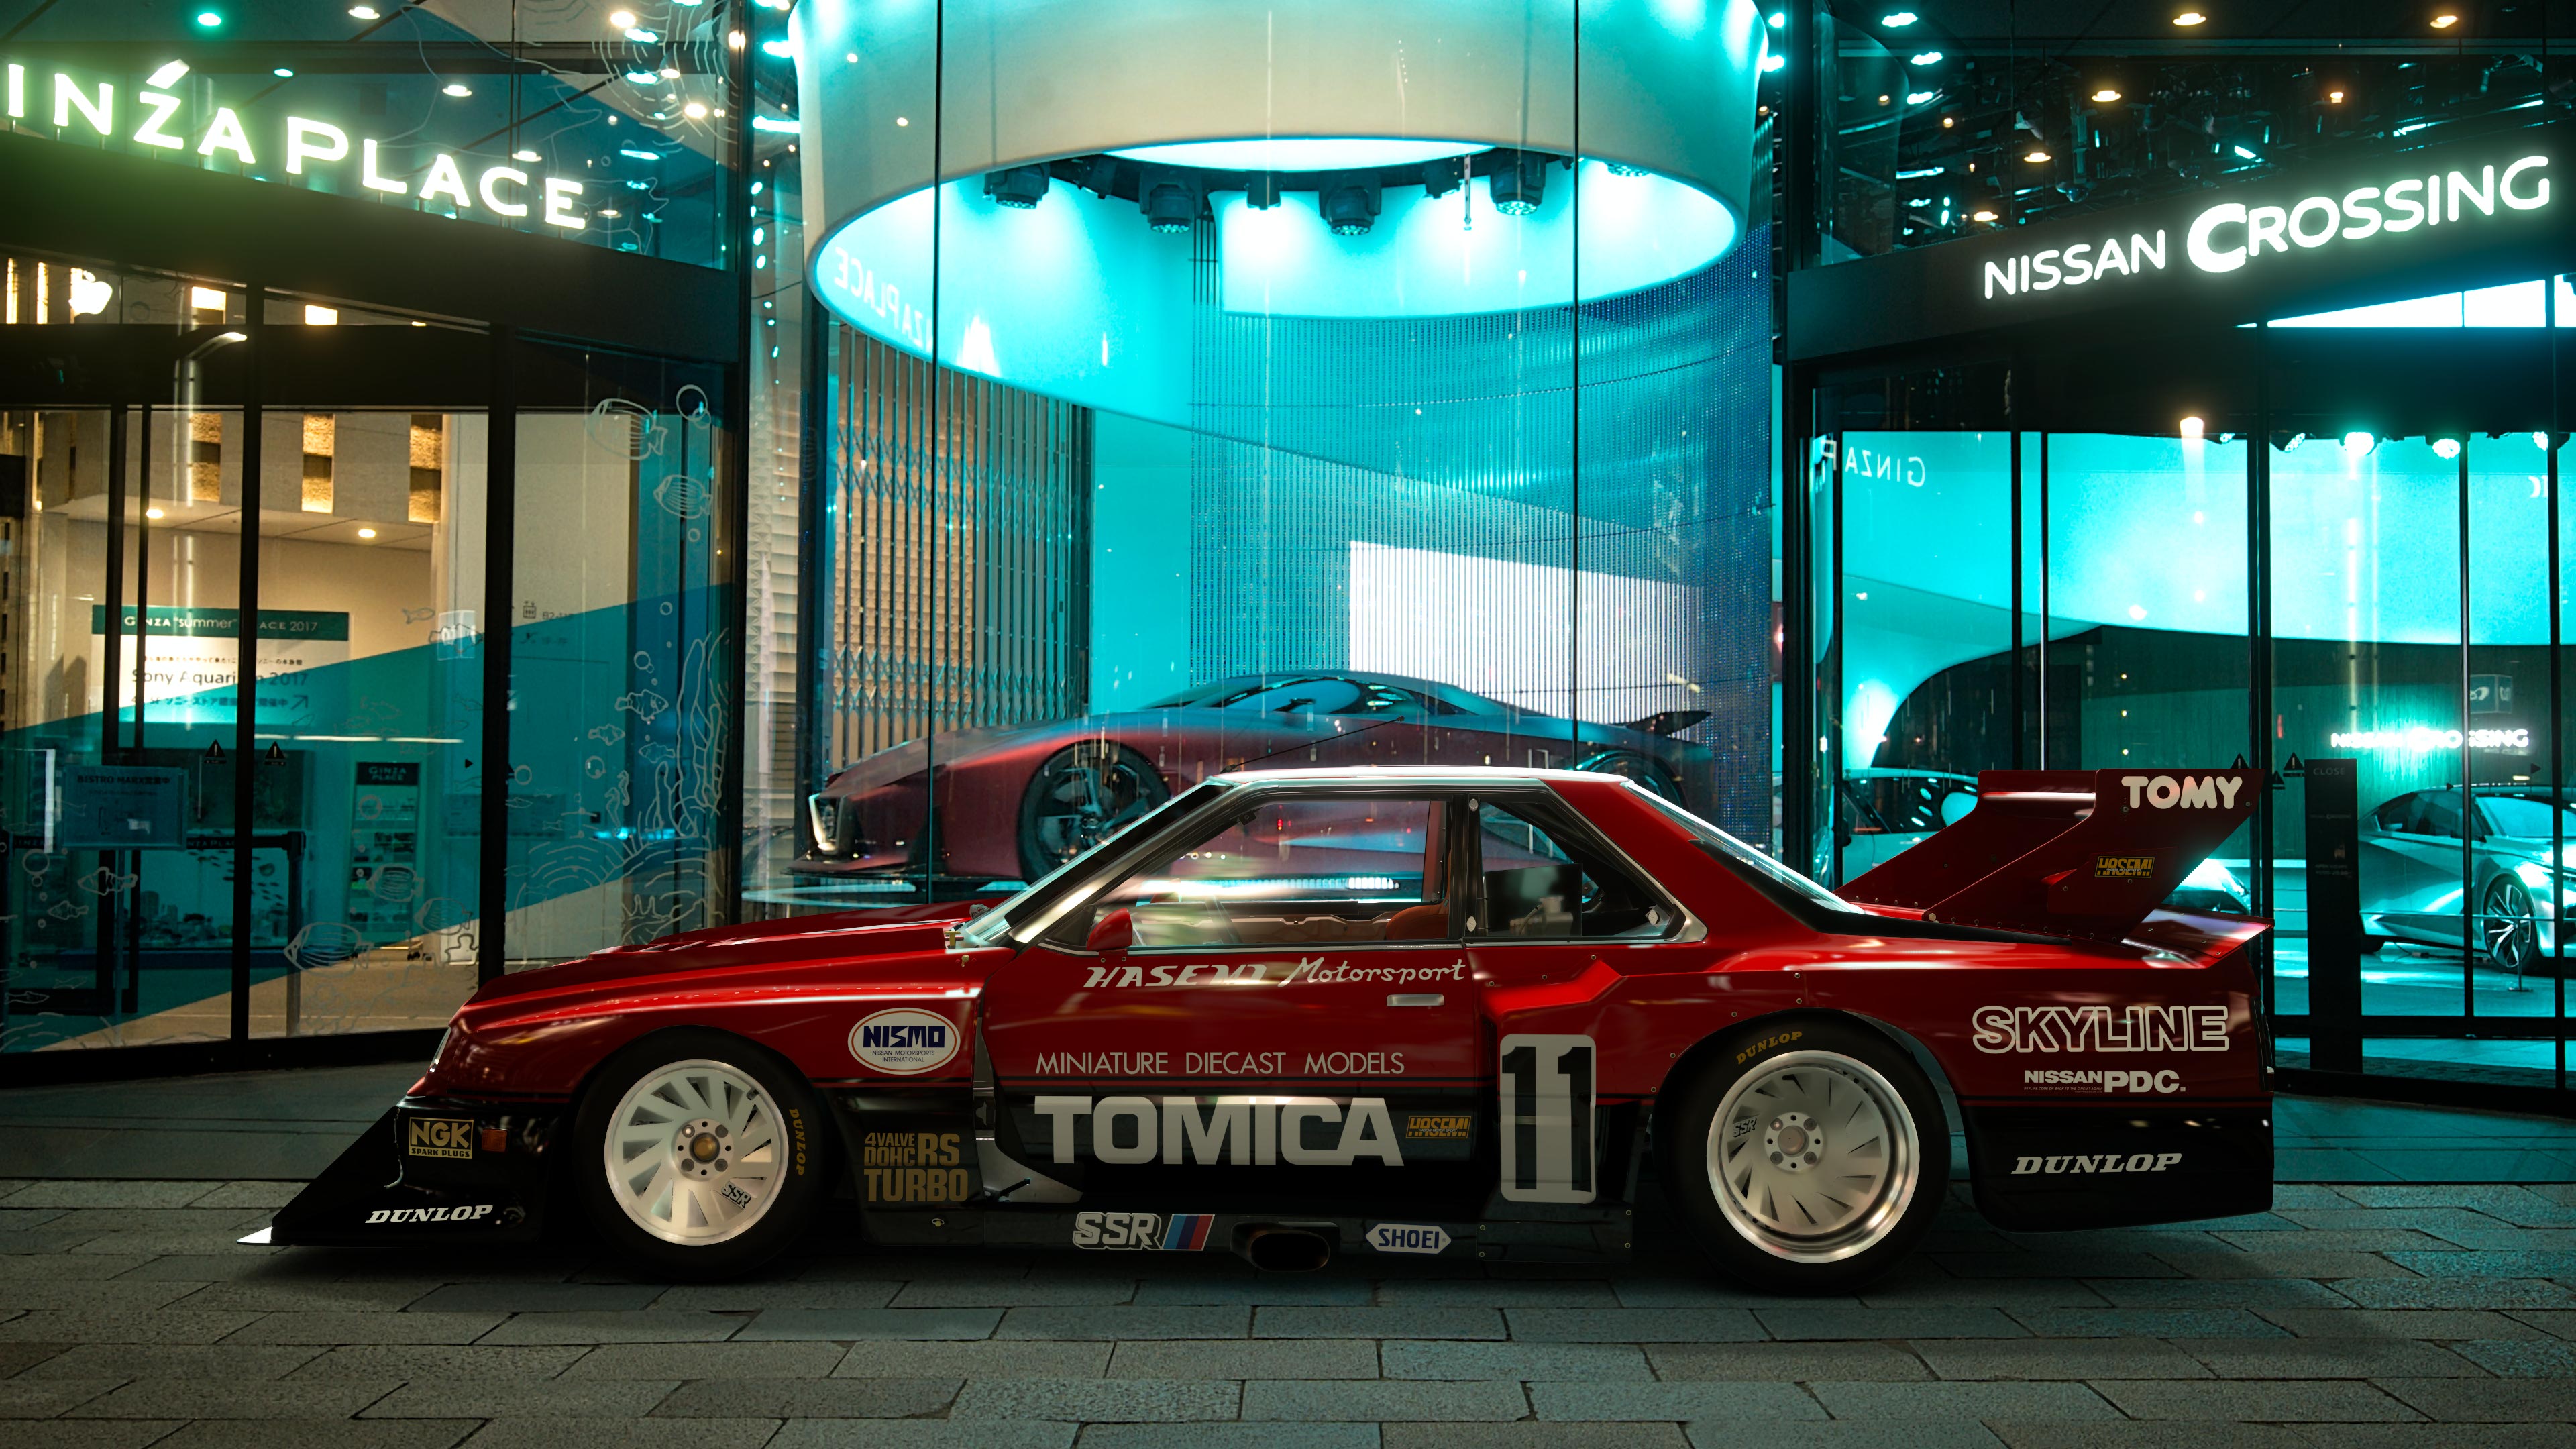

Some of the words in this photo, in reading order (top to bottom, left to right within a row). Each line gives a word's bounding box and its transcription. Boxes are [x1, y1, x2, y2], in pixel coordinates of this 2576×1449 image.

[286, 115, 586, 230] PLACE
[1984, 229, 2165, 299] NISSAN
[2186, 155, 2550, 274] CROSSING
[124, 616, 171, 627] GNZA
[290, 621, 318, 631] 2017
[268, 672, 309, 686] 2017
[2312, 767, 2346, 776] CLOSE
[2121, 775, 2243, 810] TOMY
[2096, 857, 2153, 877] HASEMI
[1082, 963, 1268, 988] HASEMI
[1277, 957, 1466, 987] Motorsport
[863, 1026, 945, 1048] NISMO
[1972, 1005, 2230, 1054] SKYLINE
[1736, 1030, 1803, 1065] DUNLOP
[1035, 1051, 1169, 1075] MINIATURE
[1185, 1051, 1287, 1075] DIECAST
[1304, 1051, 1405, 1075] MODELS
[2024, 1069, 2102, 1084] NISSAN
[1034, 1095, 1405, 1167] TOMICA
[1408, 1118, 1469, 1137] HASEMI
[1501, 1045, 1593, 1193] 11
[1733, 1116, 1758, 1138] SSR
[411, 1120, 471, 1149] NGK
[788, 1108, 806, 1176] DUNLOP
[863, 1146, 916, 1167] DOHC
[917, 1132, 961, 1167] RS
[2010, 1152, 2182, 1175] DUNLOP
[721, 1181, 752, 1209] SSR
[863, 1168, 968, 1203] TURBO
[365, 1204, 493, 1224] DUNLOP
[1073, 1212, 1161, 1250] SSR
[1378, 1228, 1440, 1249] SHOEI
